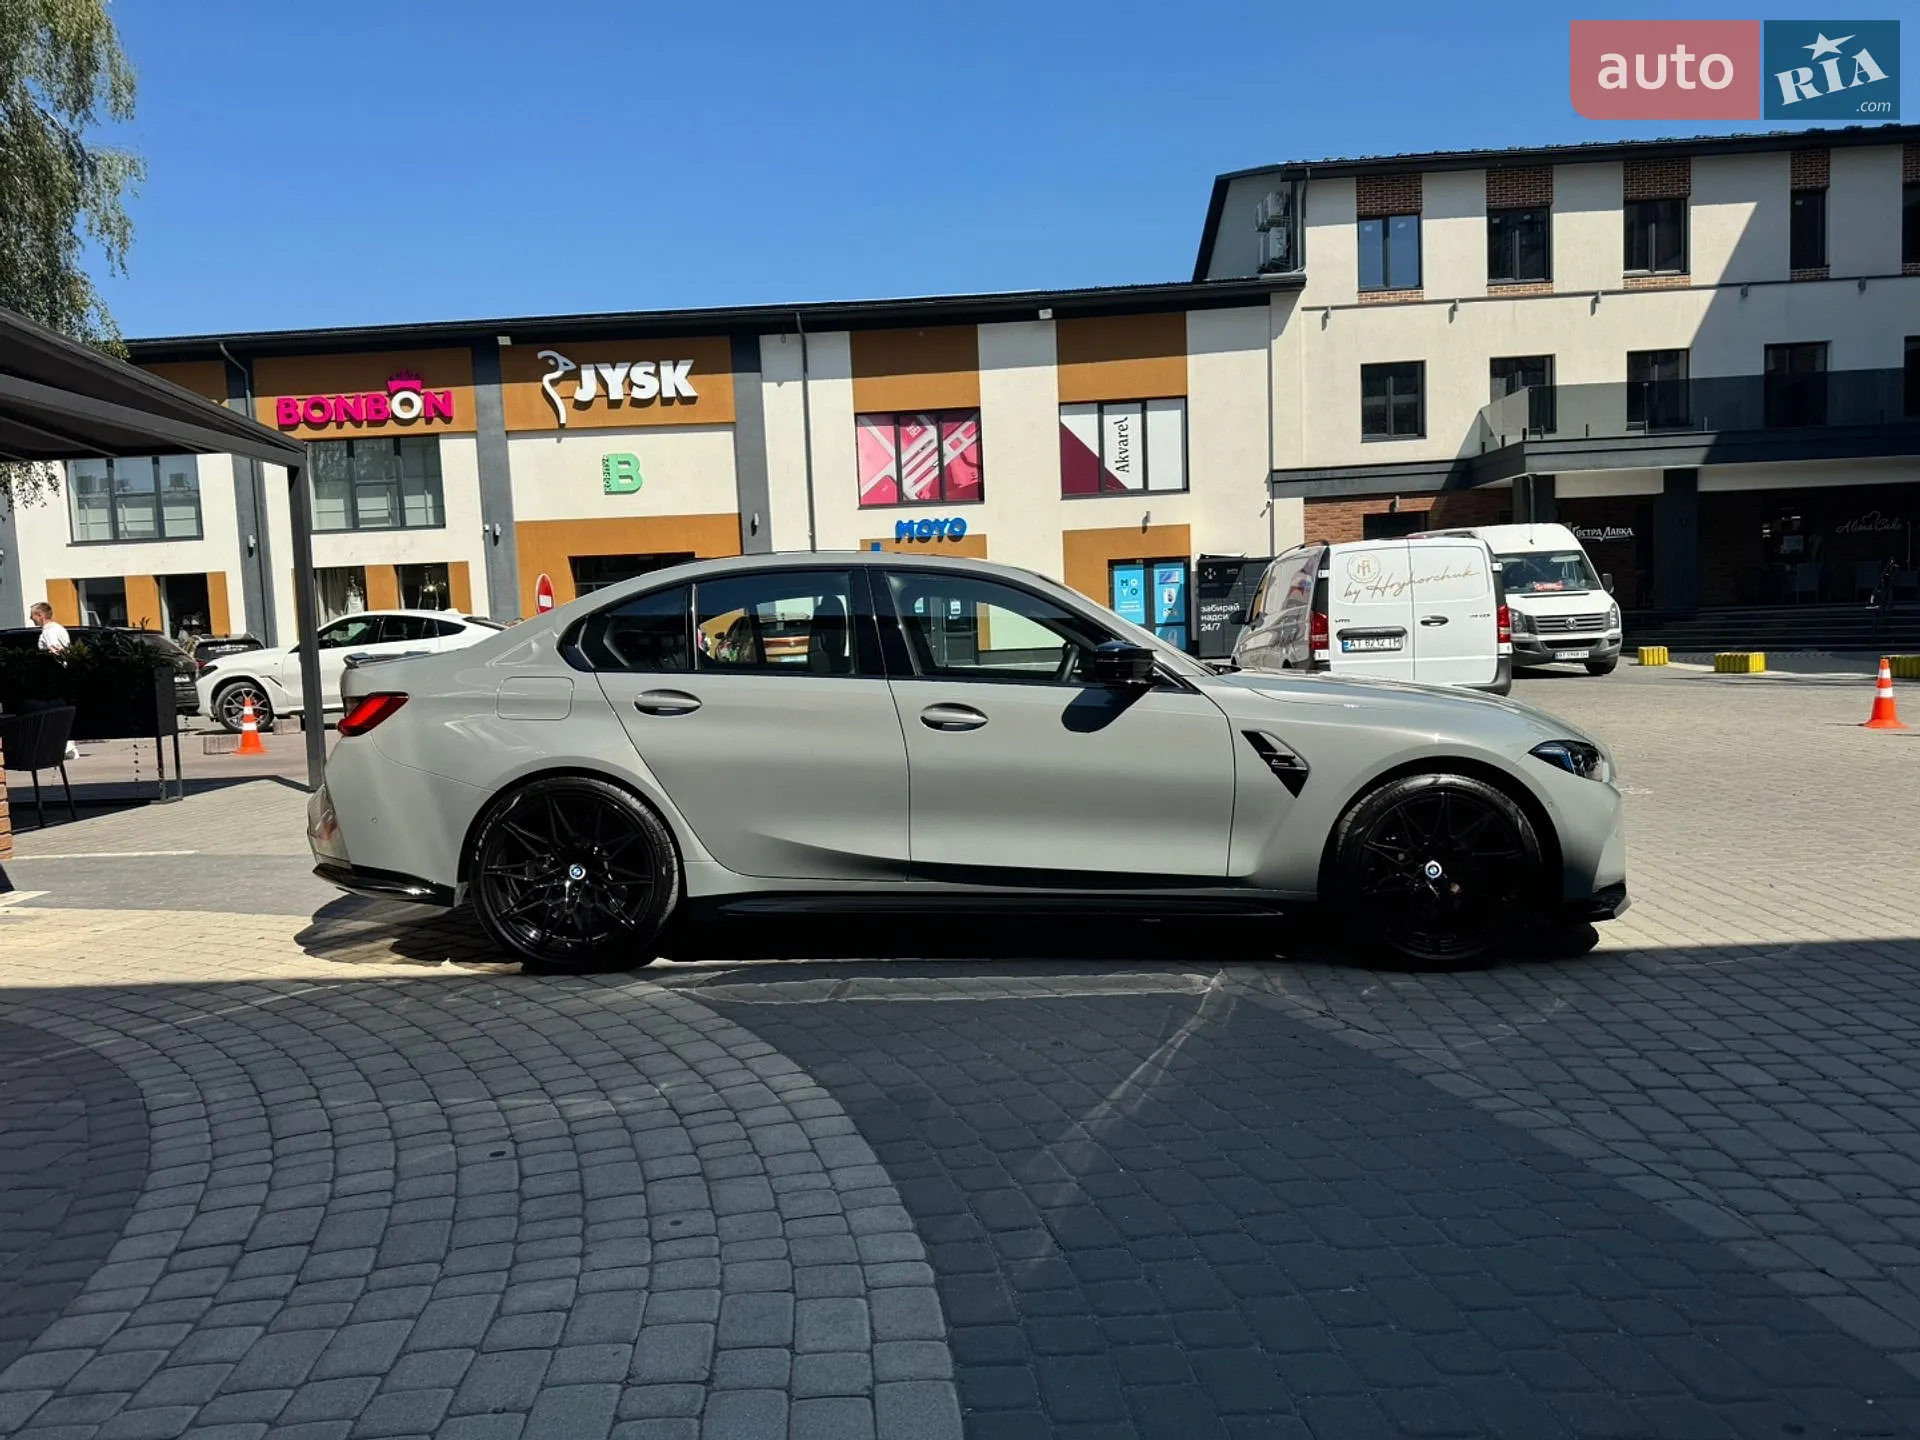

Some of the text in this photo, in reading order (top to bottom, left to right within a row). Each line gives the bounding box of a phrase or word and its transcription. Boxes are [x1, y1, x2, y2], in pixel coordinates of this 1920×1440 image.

[574, 359, 698, 402] JYSK
[276, 390, 453, 428] BONBON
[1113, 416, 1130, 473] Akvarel
[895, 517, 967, 540] MOYO
[1344, 582, 1361, 603] by
[1200, 603, 1240, 615] забирай
[1201, 614, 1229, 623] надси
[1201, 623, 1221, 632] 24/7
